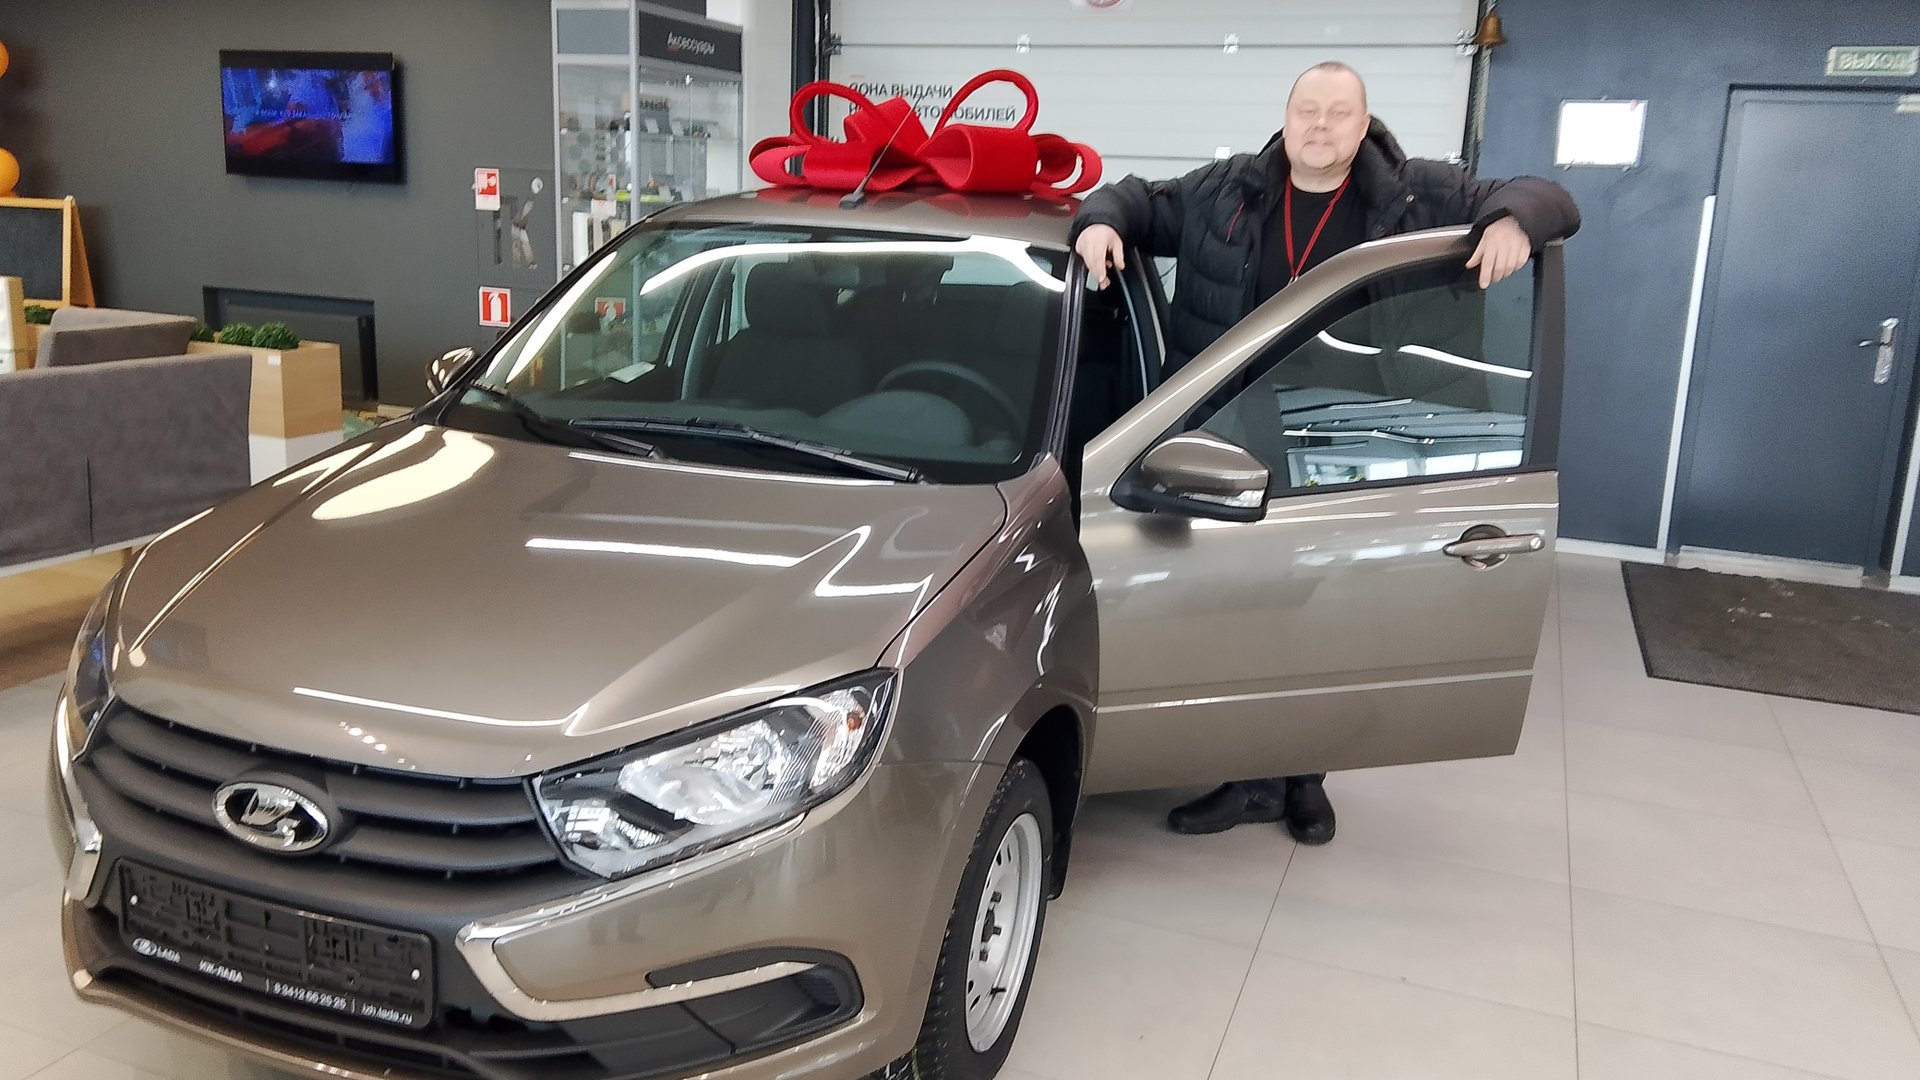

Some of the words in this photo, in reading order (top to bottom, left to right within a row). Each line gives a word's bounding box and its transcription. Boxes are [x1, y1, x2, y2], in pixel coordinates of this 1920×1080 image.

[667, 31, 715, 55] Аксессуары
[891, 84, 953, 99] ВЫДАЧИ
[915, 104, 1016, 121] ТООБИЛЕЙ
